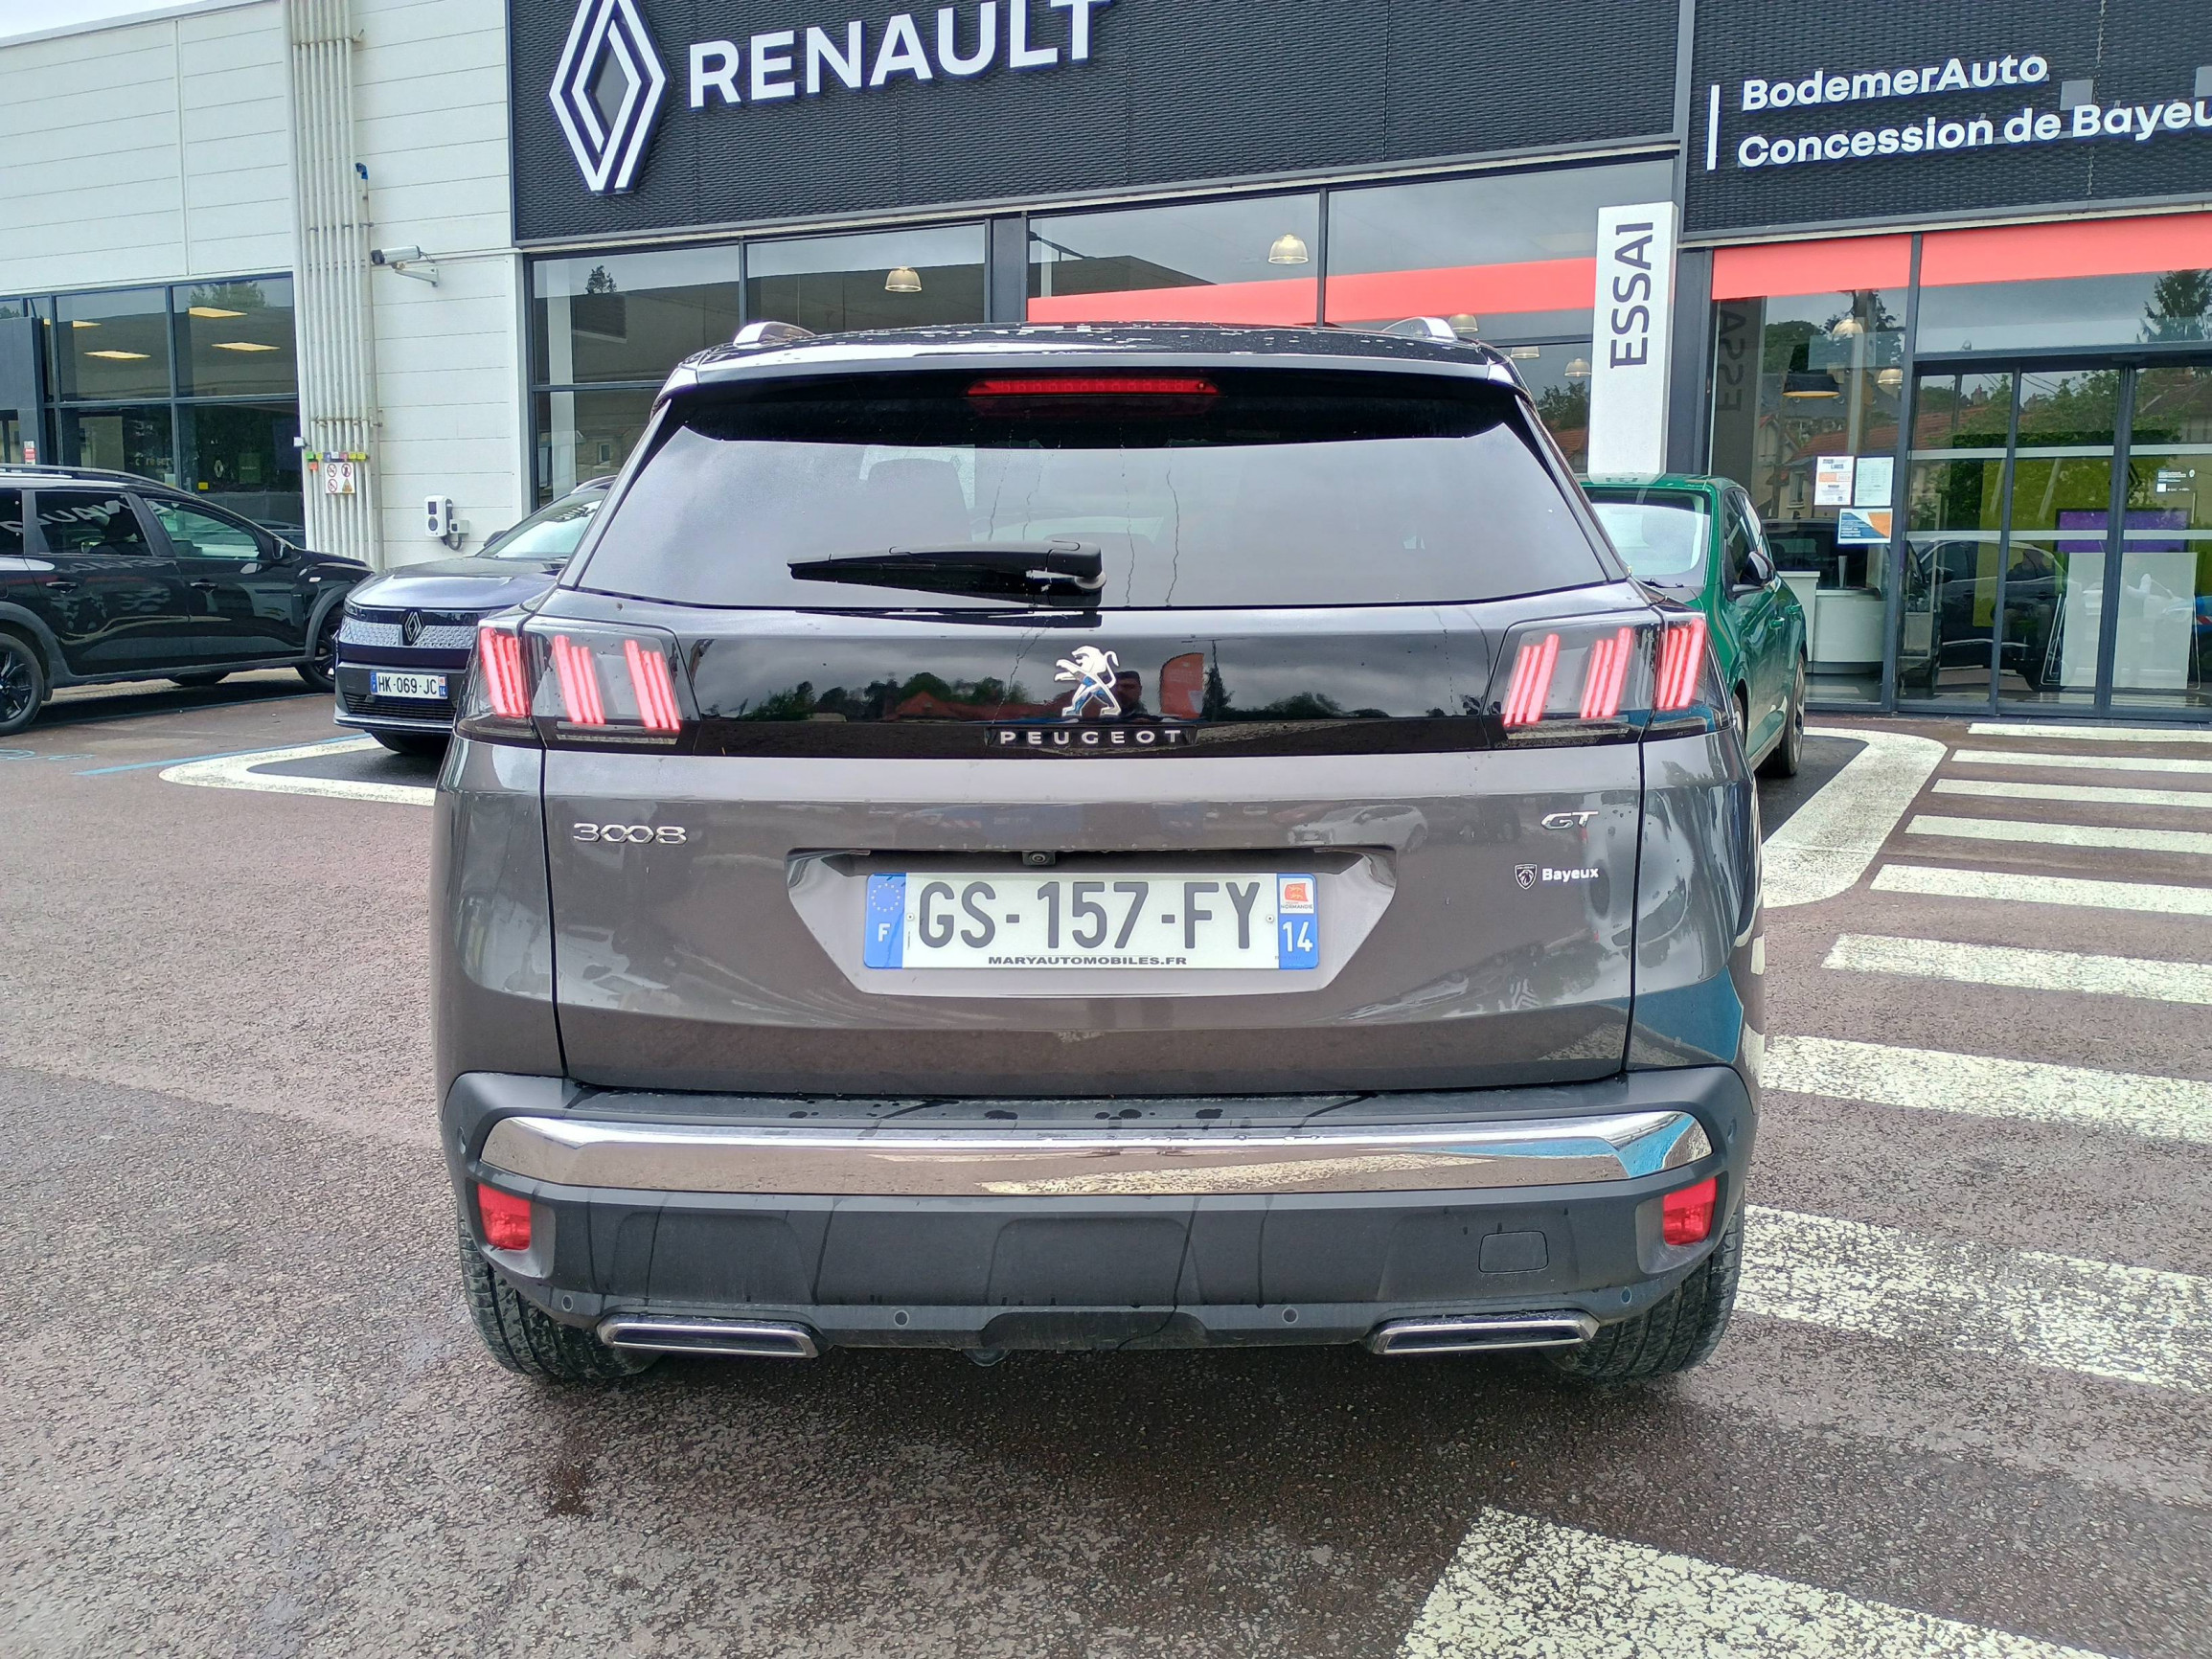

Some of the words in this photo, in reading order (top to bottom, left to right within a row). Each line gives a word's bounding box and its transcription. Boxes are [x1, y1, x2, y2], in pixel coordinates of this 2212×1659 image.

[689, 0, 1110, 108] RENAULT
[1742, 55, 2048, 111] BodemerAuto
[1738, 116, 1994, 168] Concession
[2003, 107, 2062, 142] de
[1609, 221, 1653, 370] ESSAI
[999, 729, 1181, 744] PEUGEOT
[1540, 810, 1599, 830] GT
[573, 823, 688, 844] 3008
[1541, 868, 1599, 883] Bayeux
[919, 881, 1261, 948] GS-157-FY
[878, 922, 891, 943] F
[1282, 920, 1313, 952] 14
[988, 956, 1187, 966] MARYAUTOMOBILES.FR
